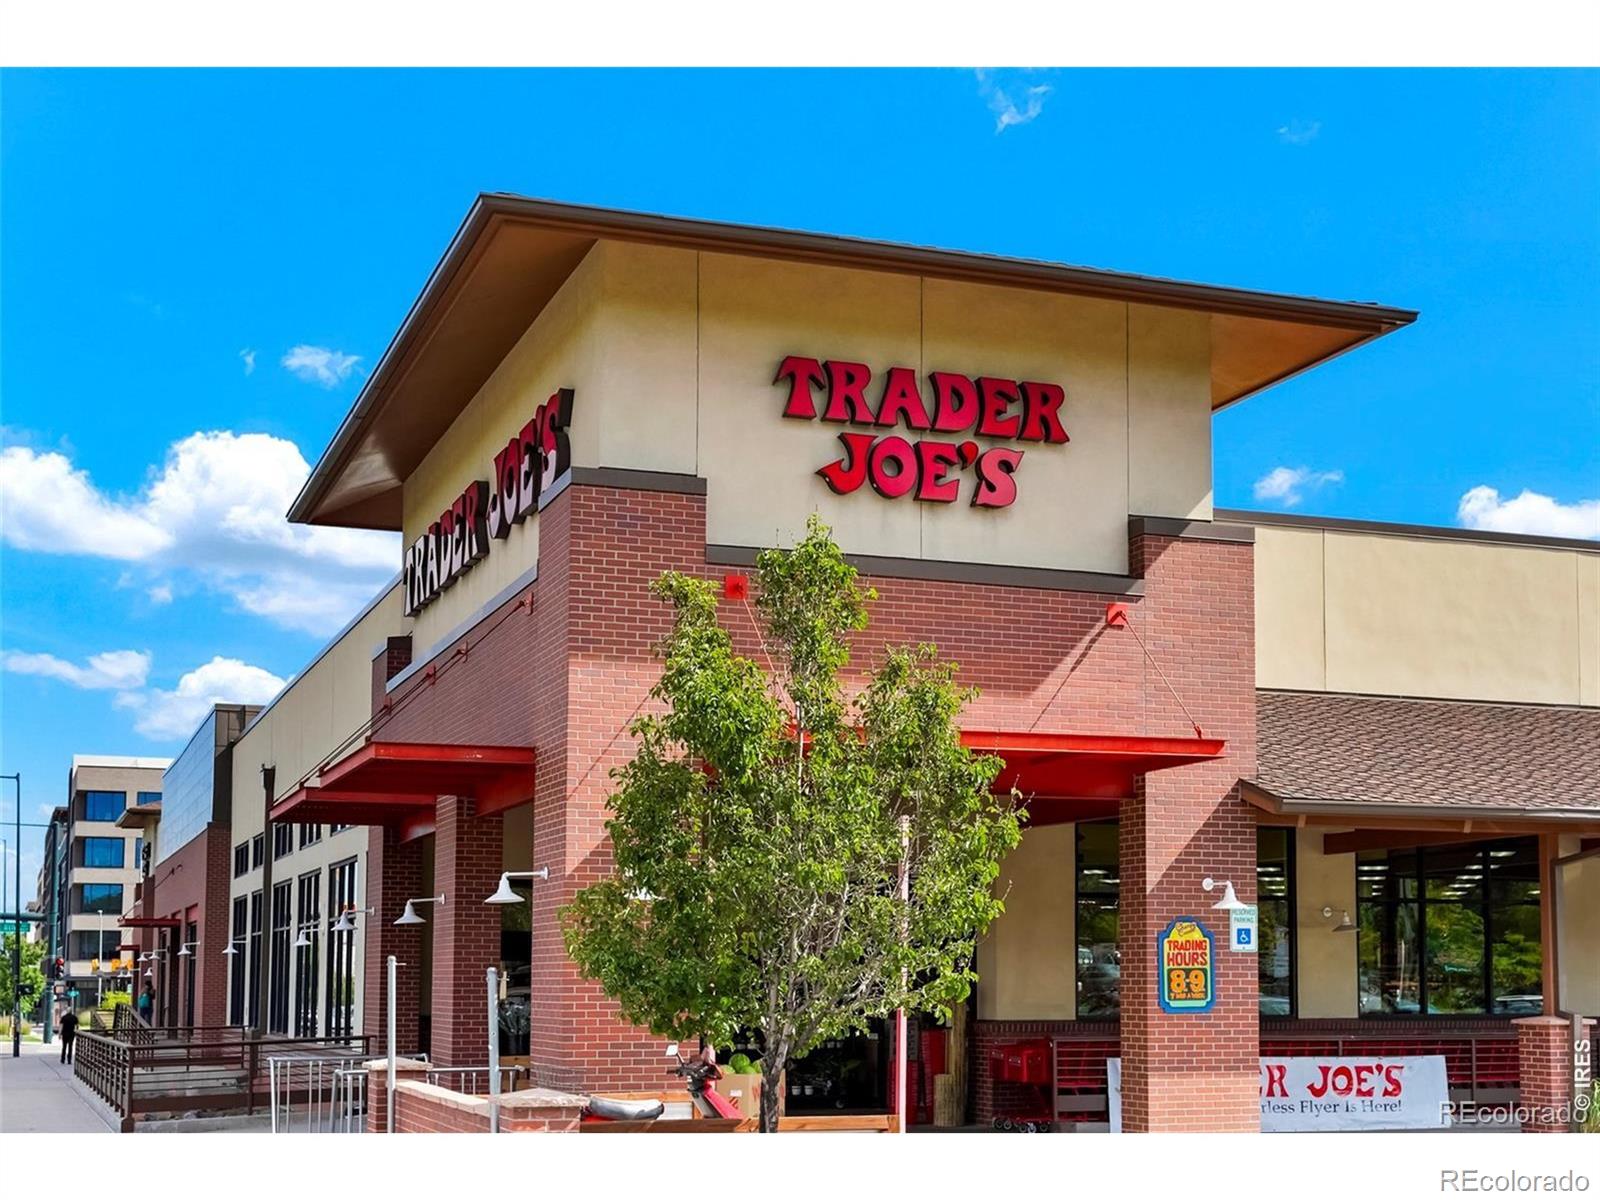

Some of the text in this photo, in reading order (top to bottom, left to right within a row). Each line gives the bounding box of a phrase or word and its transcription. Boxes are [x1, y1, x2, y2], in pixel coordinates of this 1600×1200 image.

[772, 355, 1070, 444] TRADER
[815, 432, 1025, 508] JOE'S
[403, 388, 575, 617] TRADER JOE'S
[1166, 940, 1208, 951] TRADING
[1167, 952, 1208, 967] HOURS
[1306, 1063, 1405, 1098] JOE'S
[1261, 1100, 1296, 1114] rless
[1300, 1100, 1341, 1118] Flyer
[1361, 1099, 1403, 1113] Here!
